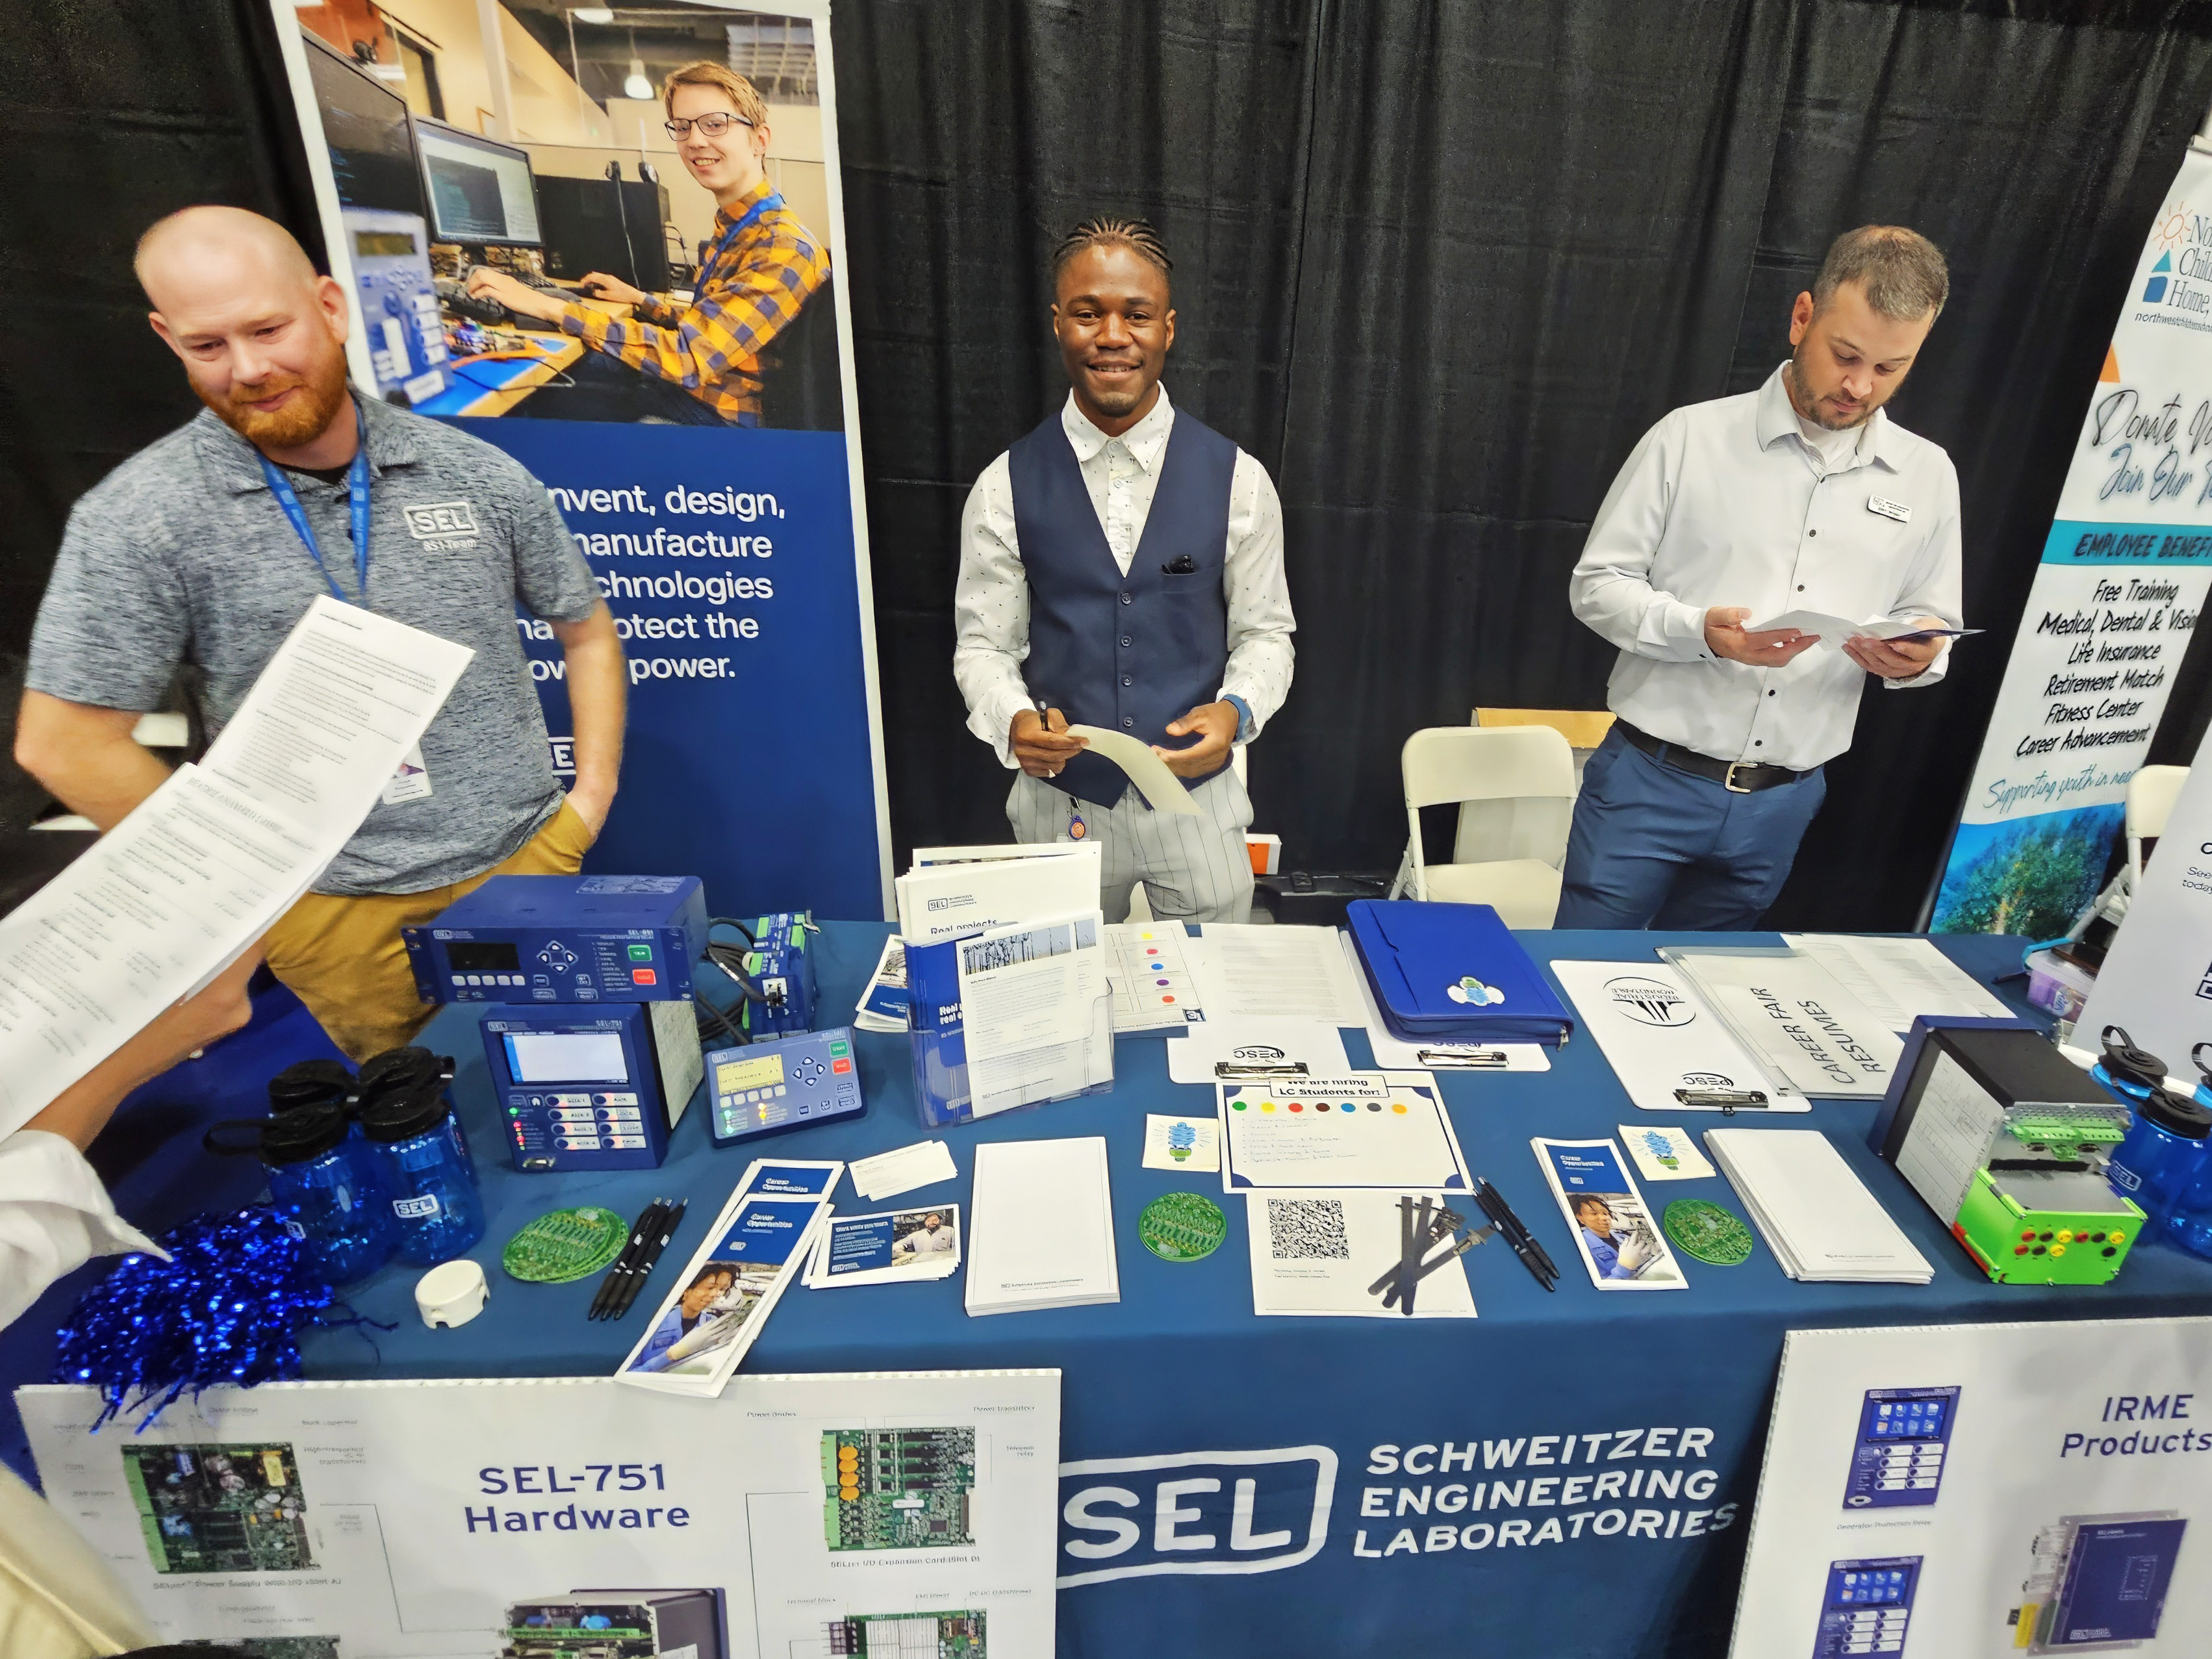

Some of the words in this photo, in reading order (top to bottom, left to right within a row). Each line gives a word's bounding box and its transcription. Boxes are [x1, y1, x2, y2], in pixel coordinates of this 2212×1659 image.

[2167, 280, 2209, 319] Home,
[2092, 390, 2181, 446] Donate
[2100, 443, 2145, 500] Join
[2150, 444, 2193, 501] Our
[547, 486, 655, 516] nvent,
[665, 485, 785, 522] design,
[414, 509, 472, 533] SEL
[2074, 533, 2158, 557] EMPLOYEE
[596, 570, 774, 605] chnologies
[2092, 579, 2122, 604] Free
[2126, 578, 2179, 609] Training
[613, 611, 698, 639] otect
[704, 612, 759, 639] the
[2037, 609, 2098, 640] Medical,
[2100, 608, 2150, 633] Dental
[2148, 610, 2164, 631] &
[2067, 640, 2094, 665] Life
[2096, 640, 2161, 663] Insurance
[628, 657, 735, 685] power.
[2042, 672, 2119, 699] Retirement
[2120, 665, 2165, 690] Match
[2044, 703, 2094, 726] Fitness
[2096, 698, 2144, 719] Center
[2015, 735, 2061, 758] Career
[2059, 723, 2151, 752] Advancement
[1983, 770, 2057, 814] Supporting
[2055, 763, 2097, 801] youth
[2094, 774, 2107, 787] in
[1750, 987, 1793, 1020] FAIR
[1797, 1000, 1887, 1072] RESUMES
[1783, 1025, 1856, 1083] CAREER
[398, 1201, 433, 1215] SEL
[2102, 1394, 2194, 1422] IRME
[1366, 1428, 1714, 1475] SCHWEITZER
[2060, 1428, 2212, 1458] Products
[479, 1463, 665, 1494] SEL-751
[1360, 1469, 1718, 1517] ENGINEERING
[464, 1503, 690, 1532] Hardware
[1063, 1478, 1291, 1559] SEL
[1353, 1502, 1739, 1558] LABORATORIES
